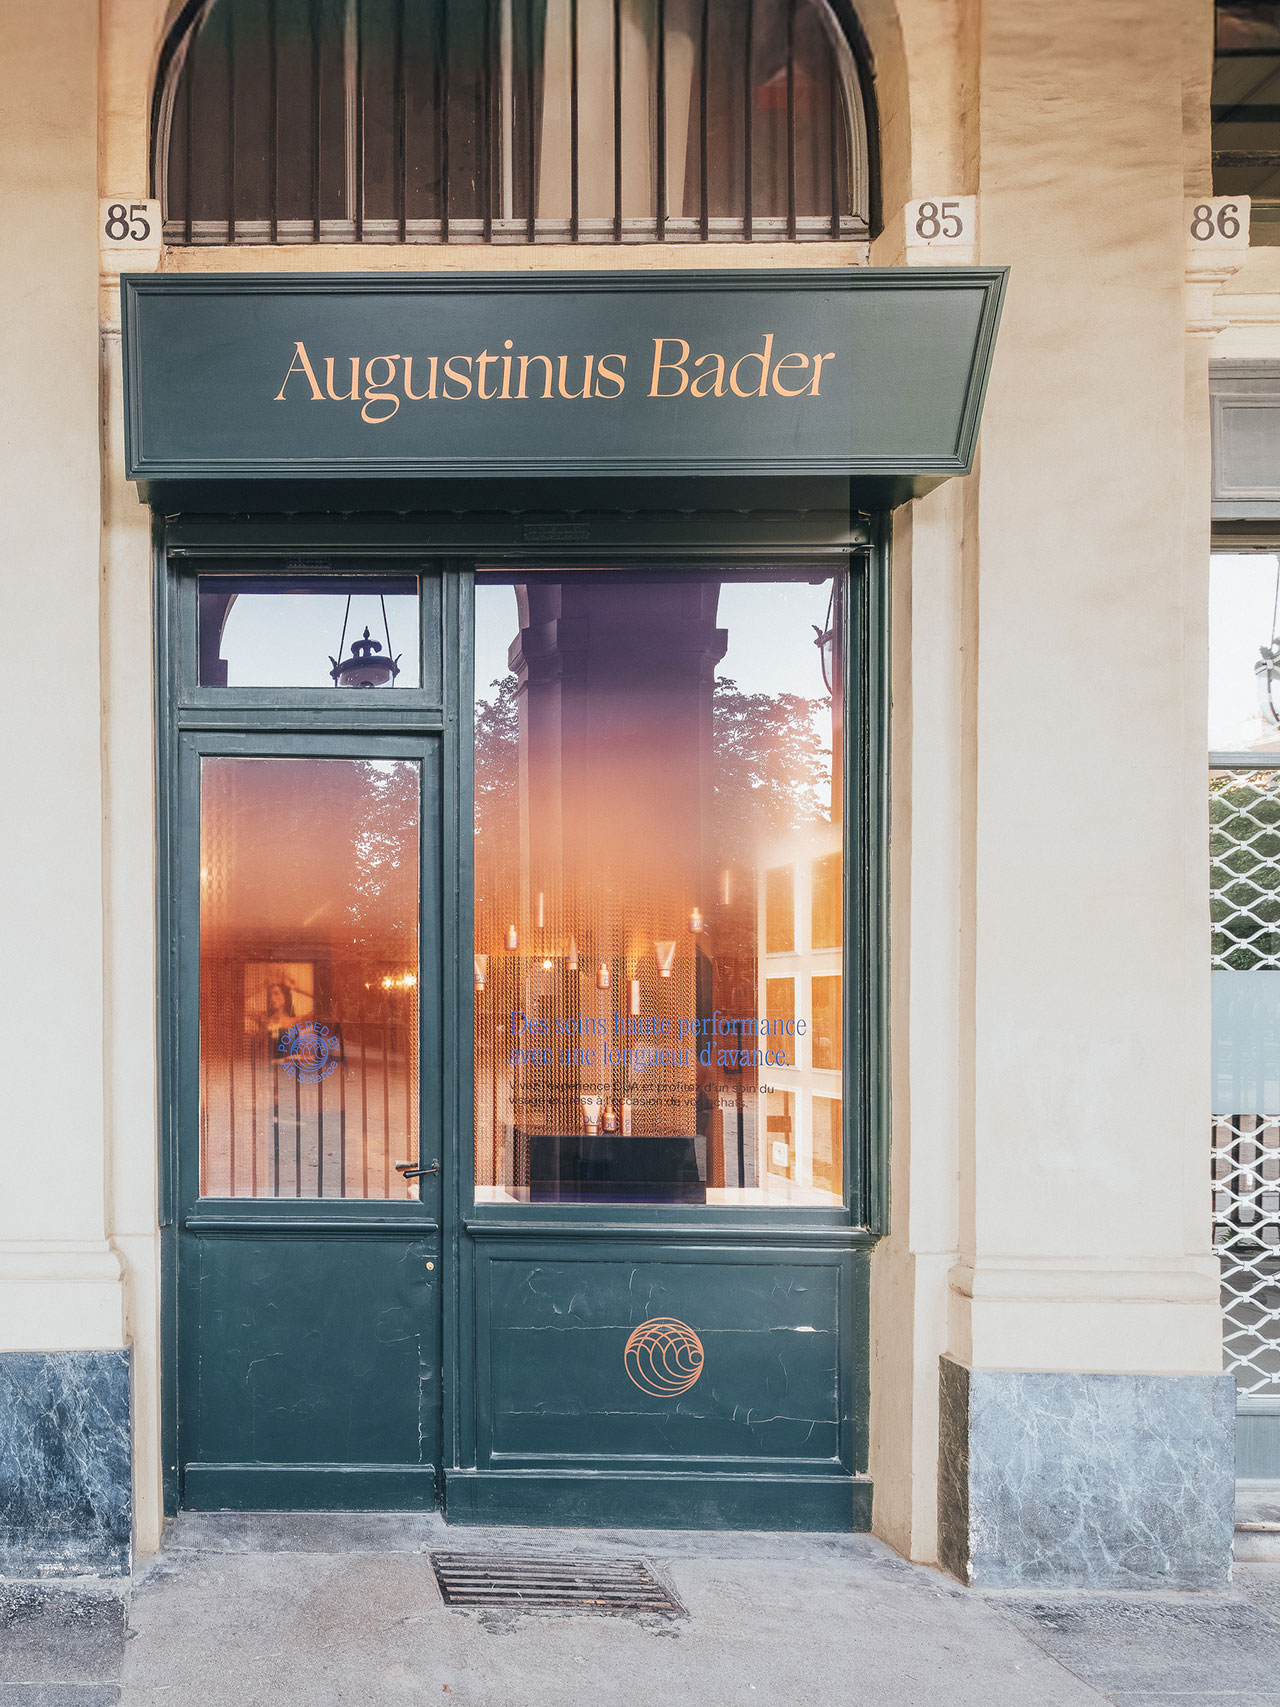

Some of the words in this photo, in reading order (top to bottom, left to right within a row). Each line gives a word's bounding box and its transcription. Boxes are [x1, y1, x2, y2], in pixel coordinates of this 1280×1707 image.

[104, 204, 151, 242] 85
[915, 201, 963, 239] 85
[1190, 203, 1240, 241] 86
[273, 340, 627, 425] Augustinus
[647, 333, 836, 398] Bader
[278, 1021, 329, 1053] POWERED
[327, 1035, 340, 1051] BY
[509, 1010, 549, 1035] Des
[555, 1012, 607, 1035] soins
[615, 1010, 671, 1036] haute
[678, 1010, 807, 1041] performance
[280, 1061, 297, 1077] AB
[297, 1060, 338, 1084] Science
[509, 1048, 553, 1066] avec
[560, 1048, 596, 1066] une
[603, 1041, 693, 1072] longueur
[596, 1096, 603, 1106] à
[707, 1097, 749, 1109] chats.
[760, 1084, 775, 1094] du
